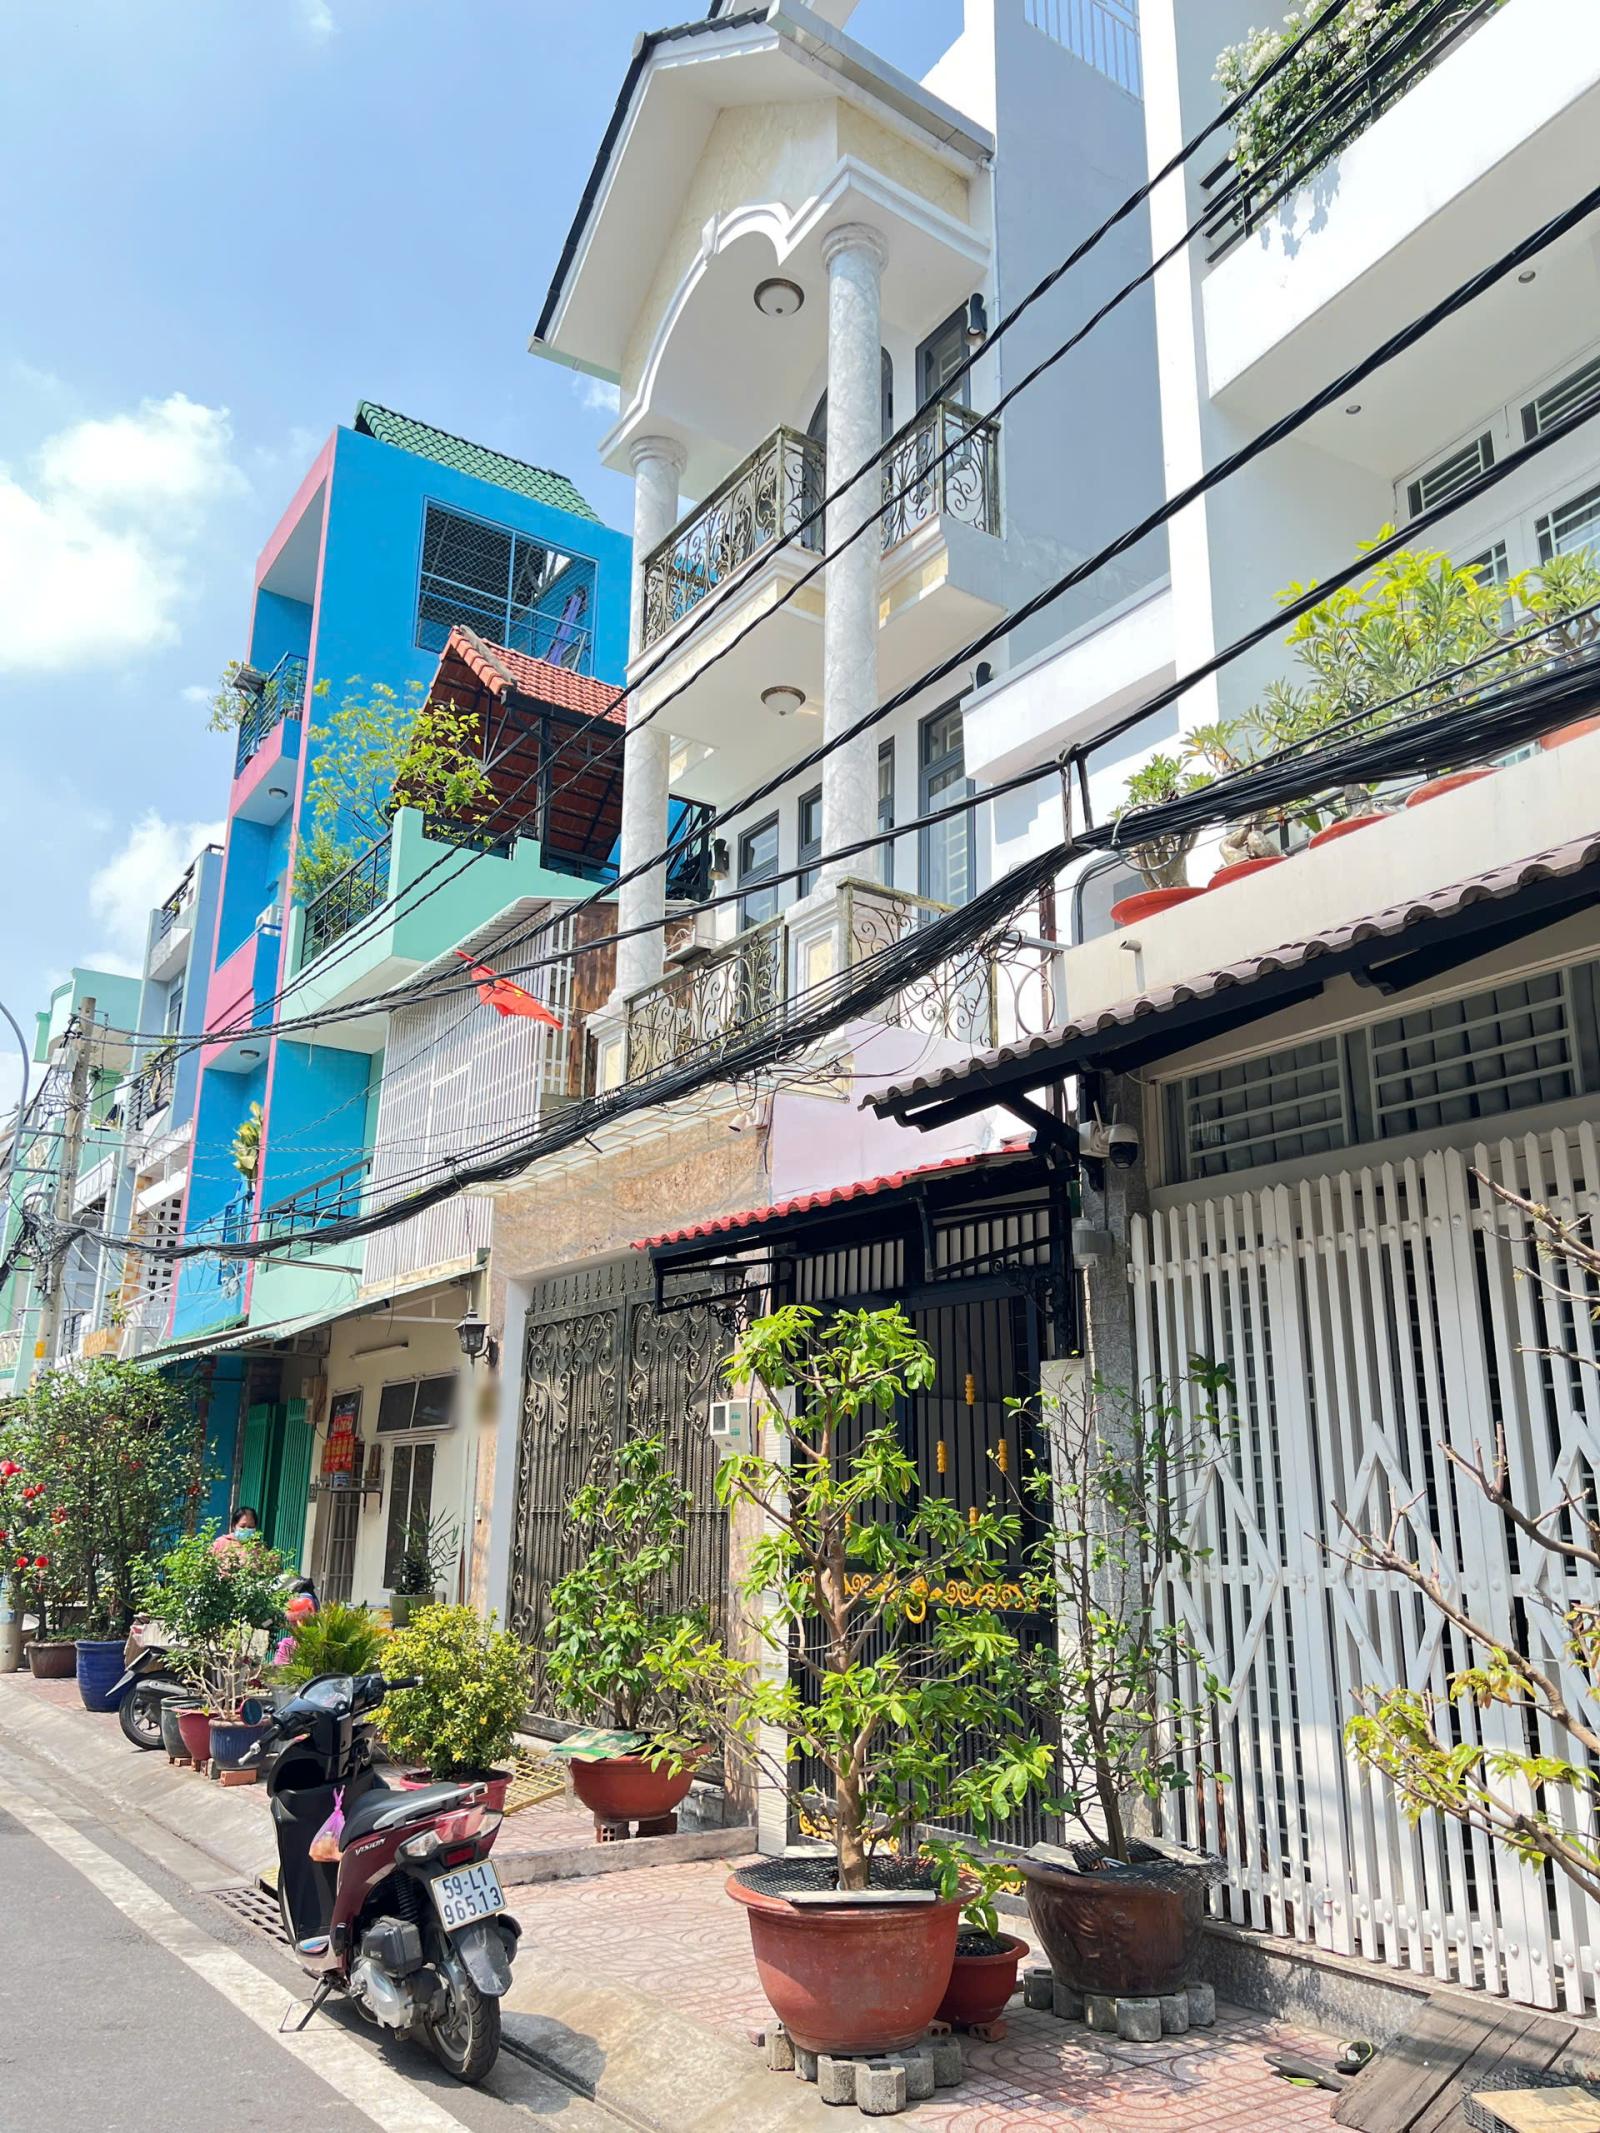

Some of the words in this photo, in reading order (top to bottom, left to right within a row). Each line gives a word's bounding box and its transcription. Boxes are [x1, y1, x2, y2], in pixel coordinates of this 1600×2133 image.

[355, 1838, 386, 1856] VISION
[442, 1866, 488, 1899] 59-L1
[443, 1886, 501, 1925] 965.13
